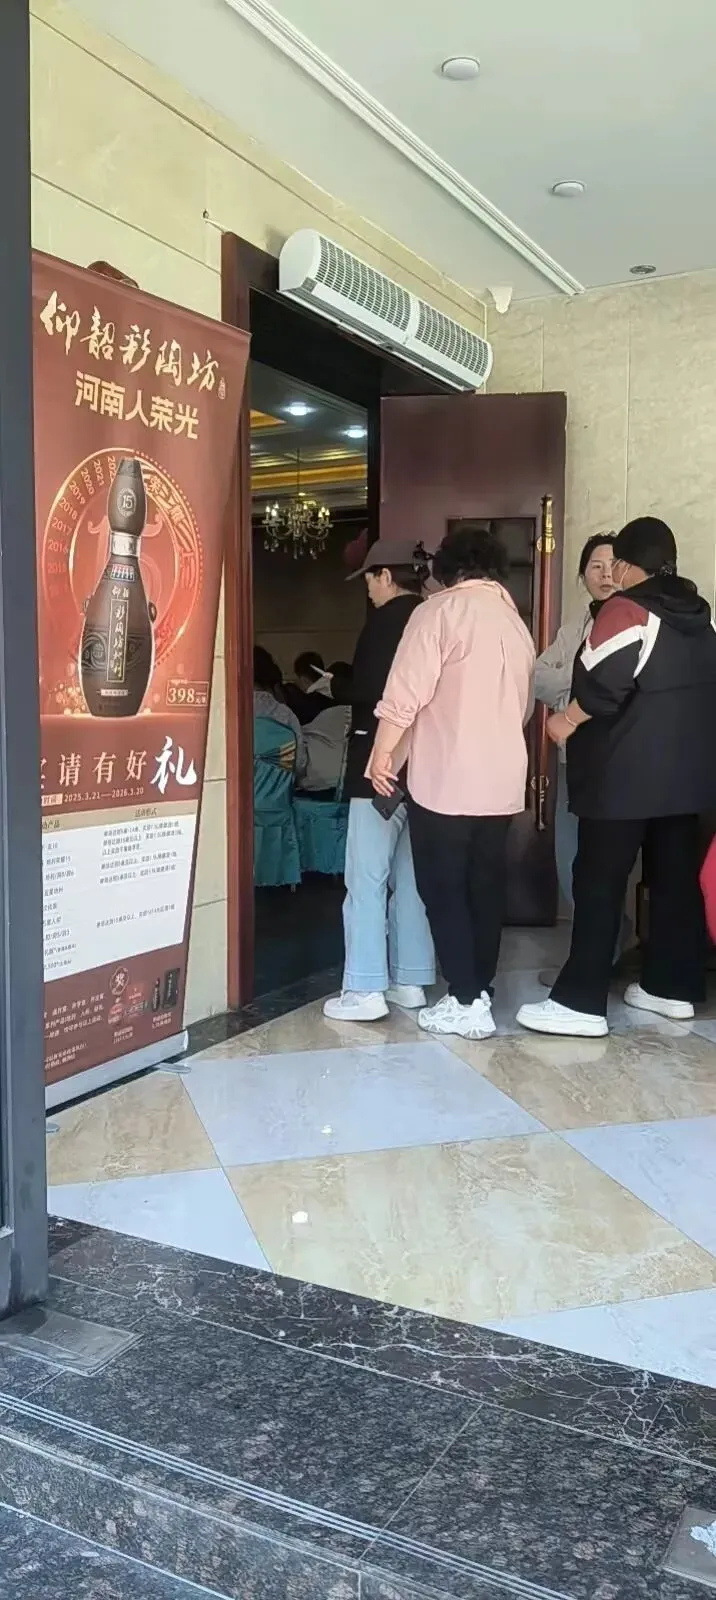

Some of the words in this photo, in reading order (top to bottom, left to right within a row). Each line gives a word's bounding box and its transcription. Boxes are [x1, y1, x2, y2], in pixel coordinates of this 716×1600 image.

[40, 291, 219, 392] 仰韶彩陶坊
[75, 371, 199, 440] 河南人荣光
[81, 467, 95, 495] 2020
[93, 460, 105, 486] 2021
[69, 480, 86, 504] 2019
[122, 494, 132, 509] 15
[59, 497, 78, 521] 2018
[52, 517, 72, 536] 2017
[168, 688, 195, 703] 398
